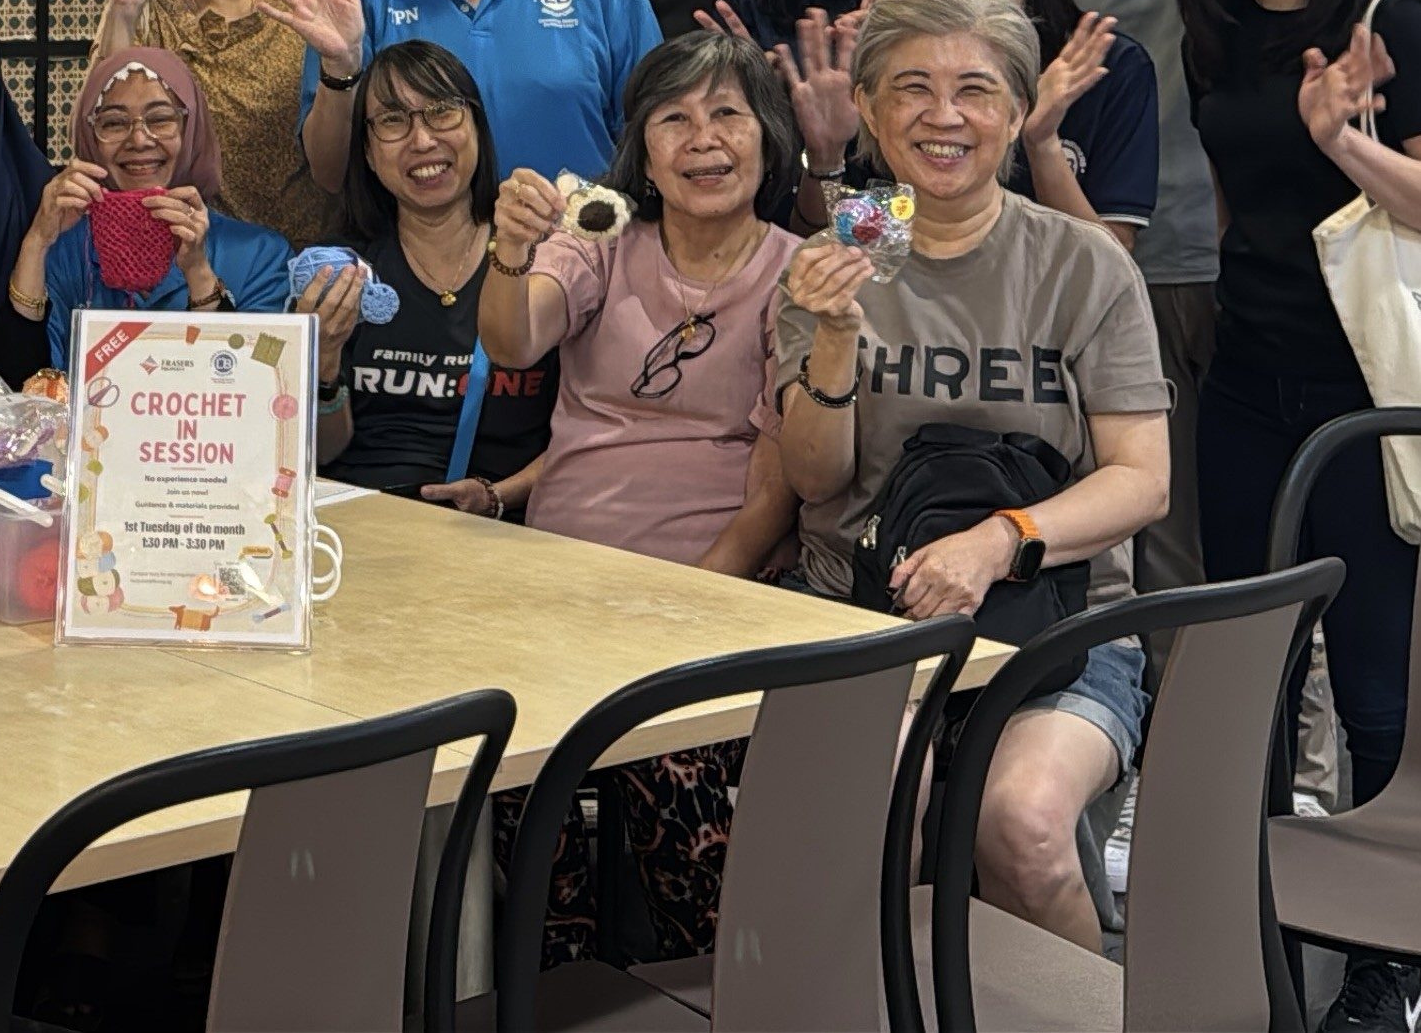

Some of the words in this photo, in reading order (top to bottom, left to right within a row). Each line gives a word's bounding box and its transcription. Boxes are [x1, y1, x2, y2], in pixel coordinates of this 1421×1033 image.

[94, 329, 130, 363] FREE
[161, 359, 195, 368] FRASERS
[373, 349, 437, 367] Family
[130, 391, 247, 418] CROCHET
[177, 419, 198, 441] IN
[139, 442, 235, 465] SESSION
[157, 476, 198, 484] experience
[135, 501, 167, 509] Guidance
[175, 502, 208, 510] materials
[208, 503, 240, 511] provided
[124, 521, 138, 533] 1st
[140, 522, 180, 535] Tuesday
[183, 523, 194, 535] of
[195, 523, 212, 534] the
[213, 524, 246, 535] month
[162, 538, 179, 549] PM
[185, 538, 207, 550] 3:30
[208, 540, 225, 551] PM
